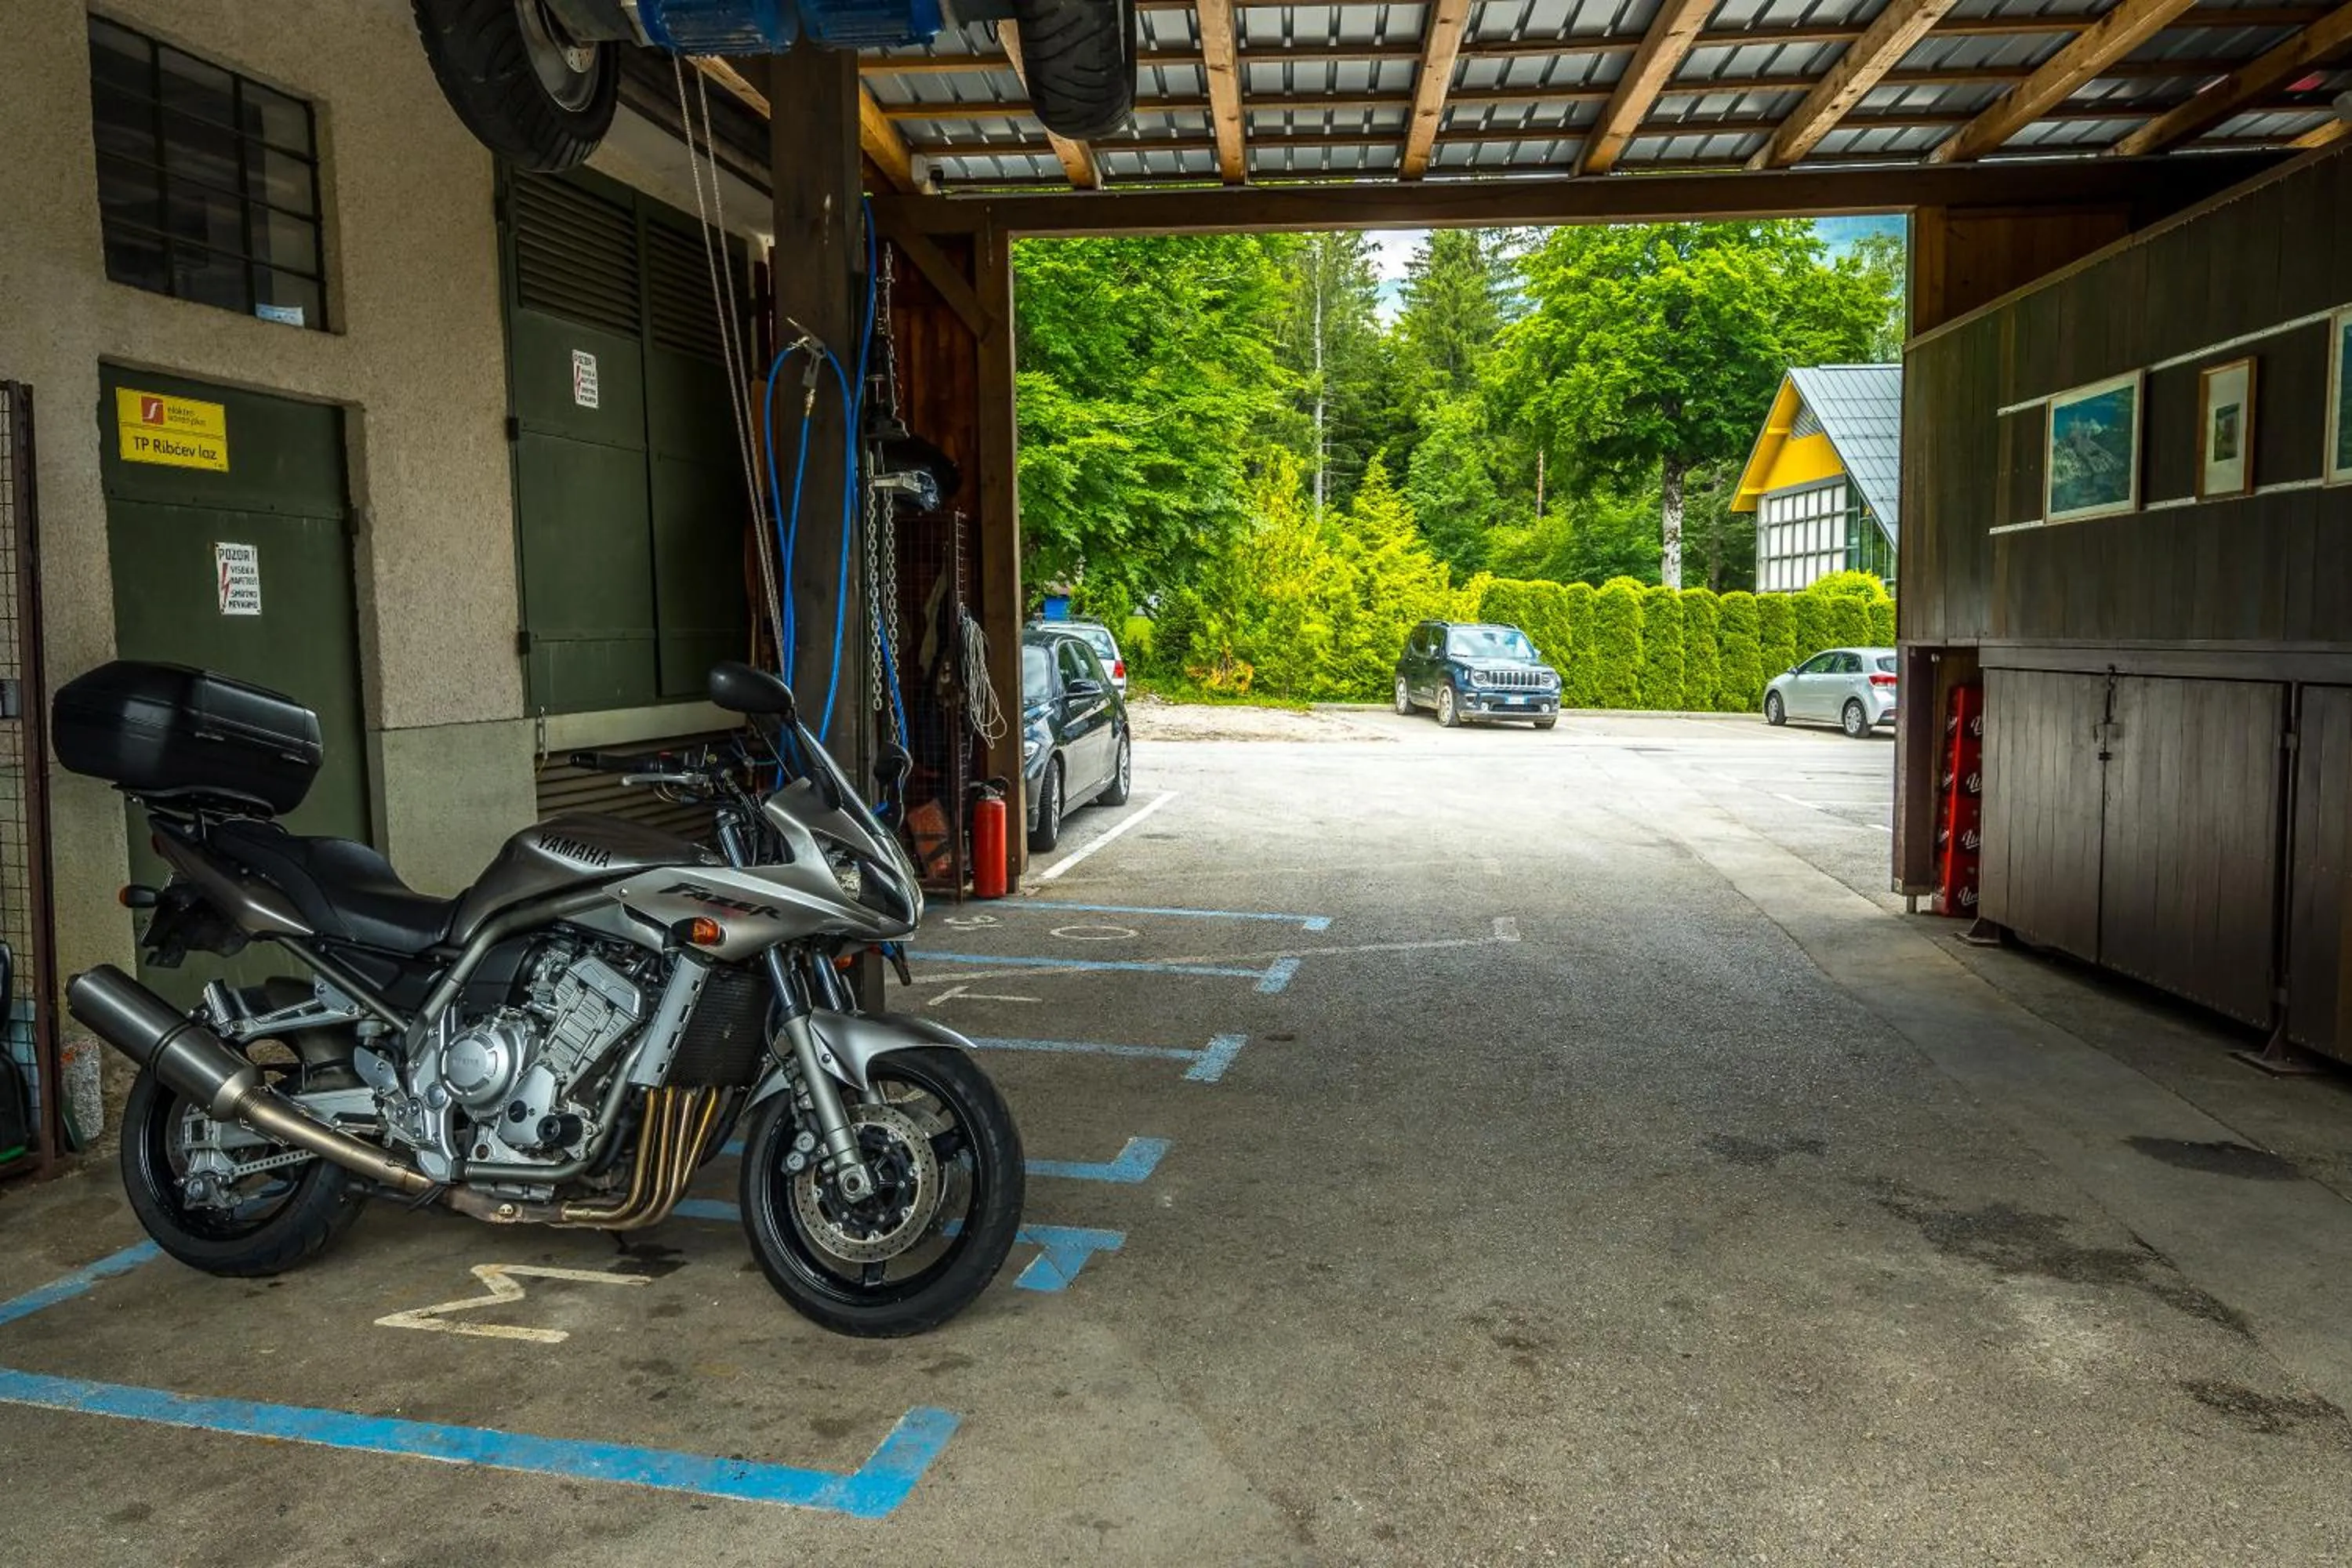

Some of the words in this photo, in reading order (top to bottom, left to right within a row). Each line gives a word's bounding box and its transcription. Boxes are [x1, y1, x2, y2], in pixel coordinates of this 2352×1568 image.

[134, 436, 150, 452] TP
[154, 437, 195, 457] Ribčev
[198, 444, 217, 460] laz
[538, 833, 613, 867] YAMAHA
[657, 882, 782, 920] FAZER
